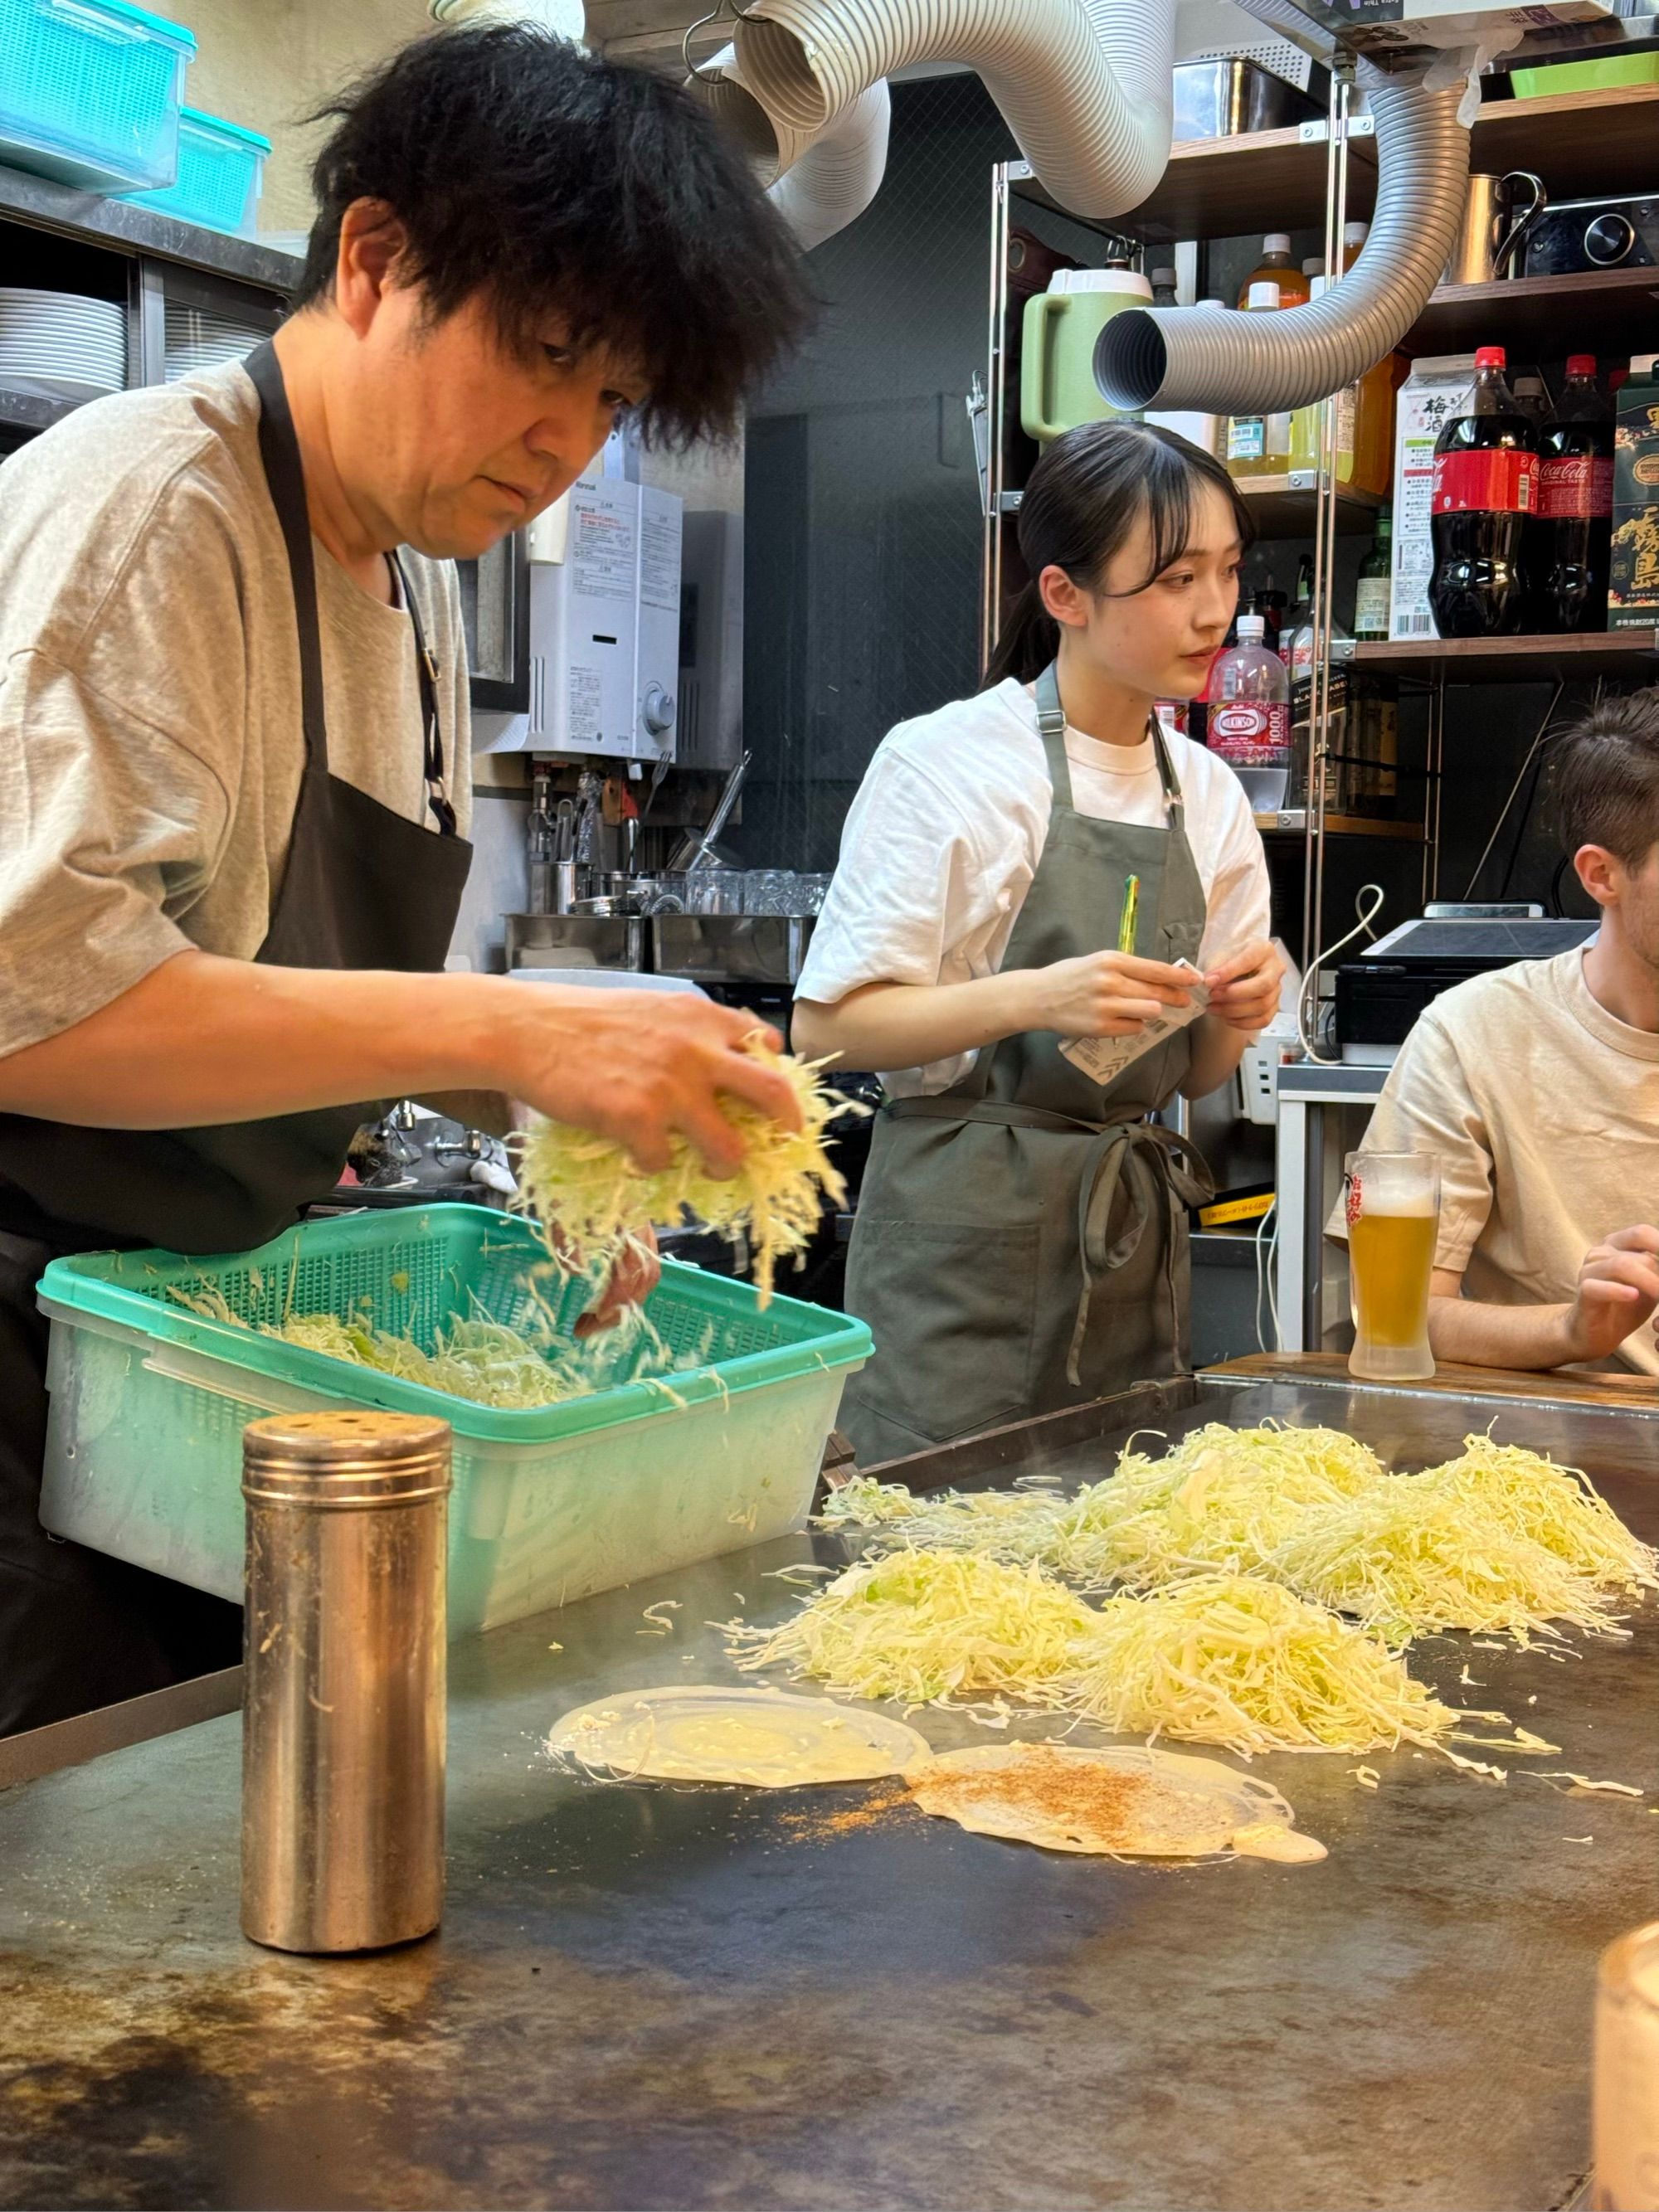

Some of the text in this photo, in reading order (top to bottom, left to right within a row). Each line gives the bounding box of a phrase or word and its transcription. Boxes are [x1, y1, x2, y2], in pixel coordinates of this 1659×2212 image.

[1423, 396, 1448, 432] 梅酒
[1540, 461, 1590, 481] Coca-Cola
[1293, 691, 1321, 704] BLAK
[1222, 716, 1256, 729] WILKINSON
[1269, 711, 1281, 744] 1000
